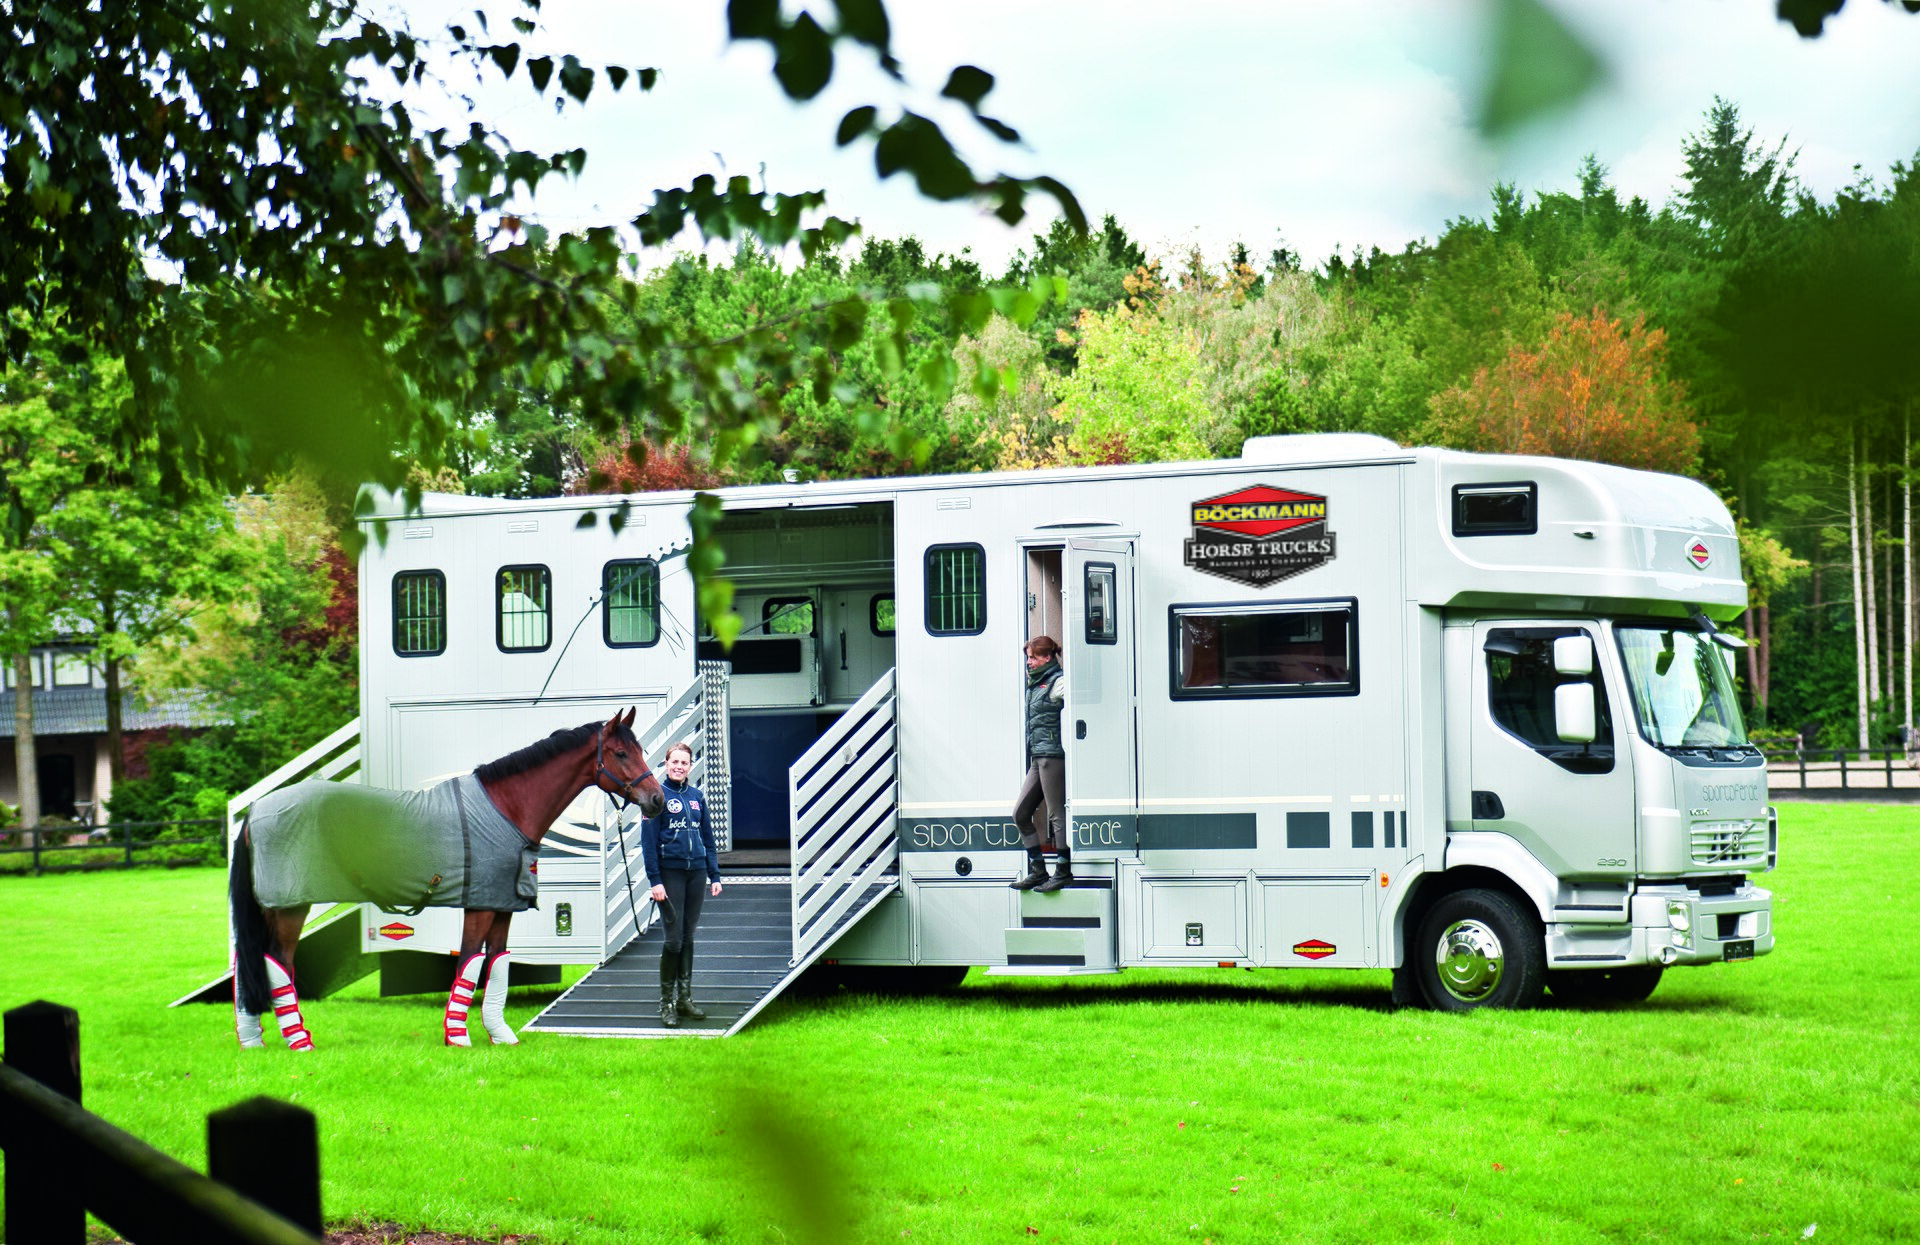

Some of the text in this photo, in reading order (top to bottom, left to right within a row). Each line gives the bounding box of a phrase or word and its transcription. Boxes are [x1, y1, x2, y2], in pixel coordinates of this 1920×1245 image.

[1193, 502, 1325, 522] BÖCKMANN
[1190, 538, 1332, 559] HORSE TRUCKS
[1597, 858, 1627, 867] 290
